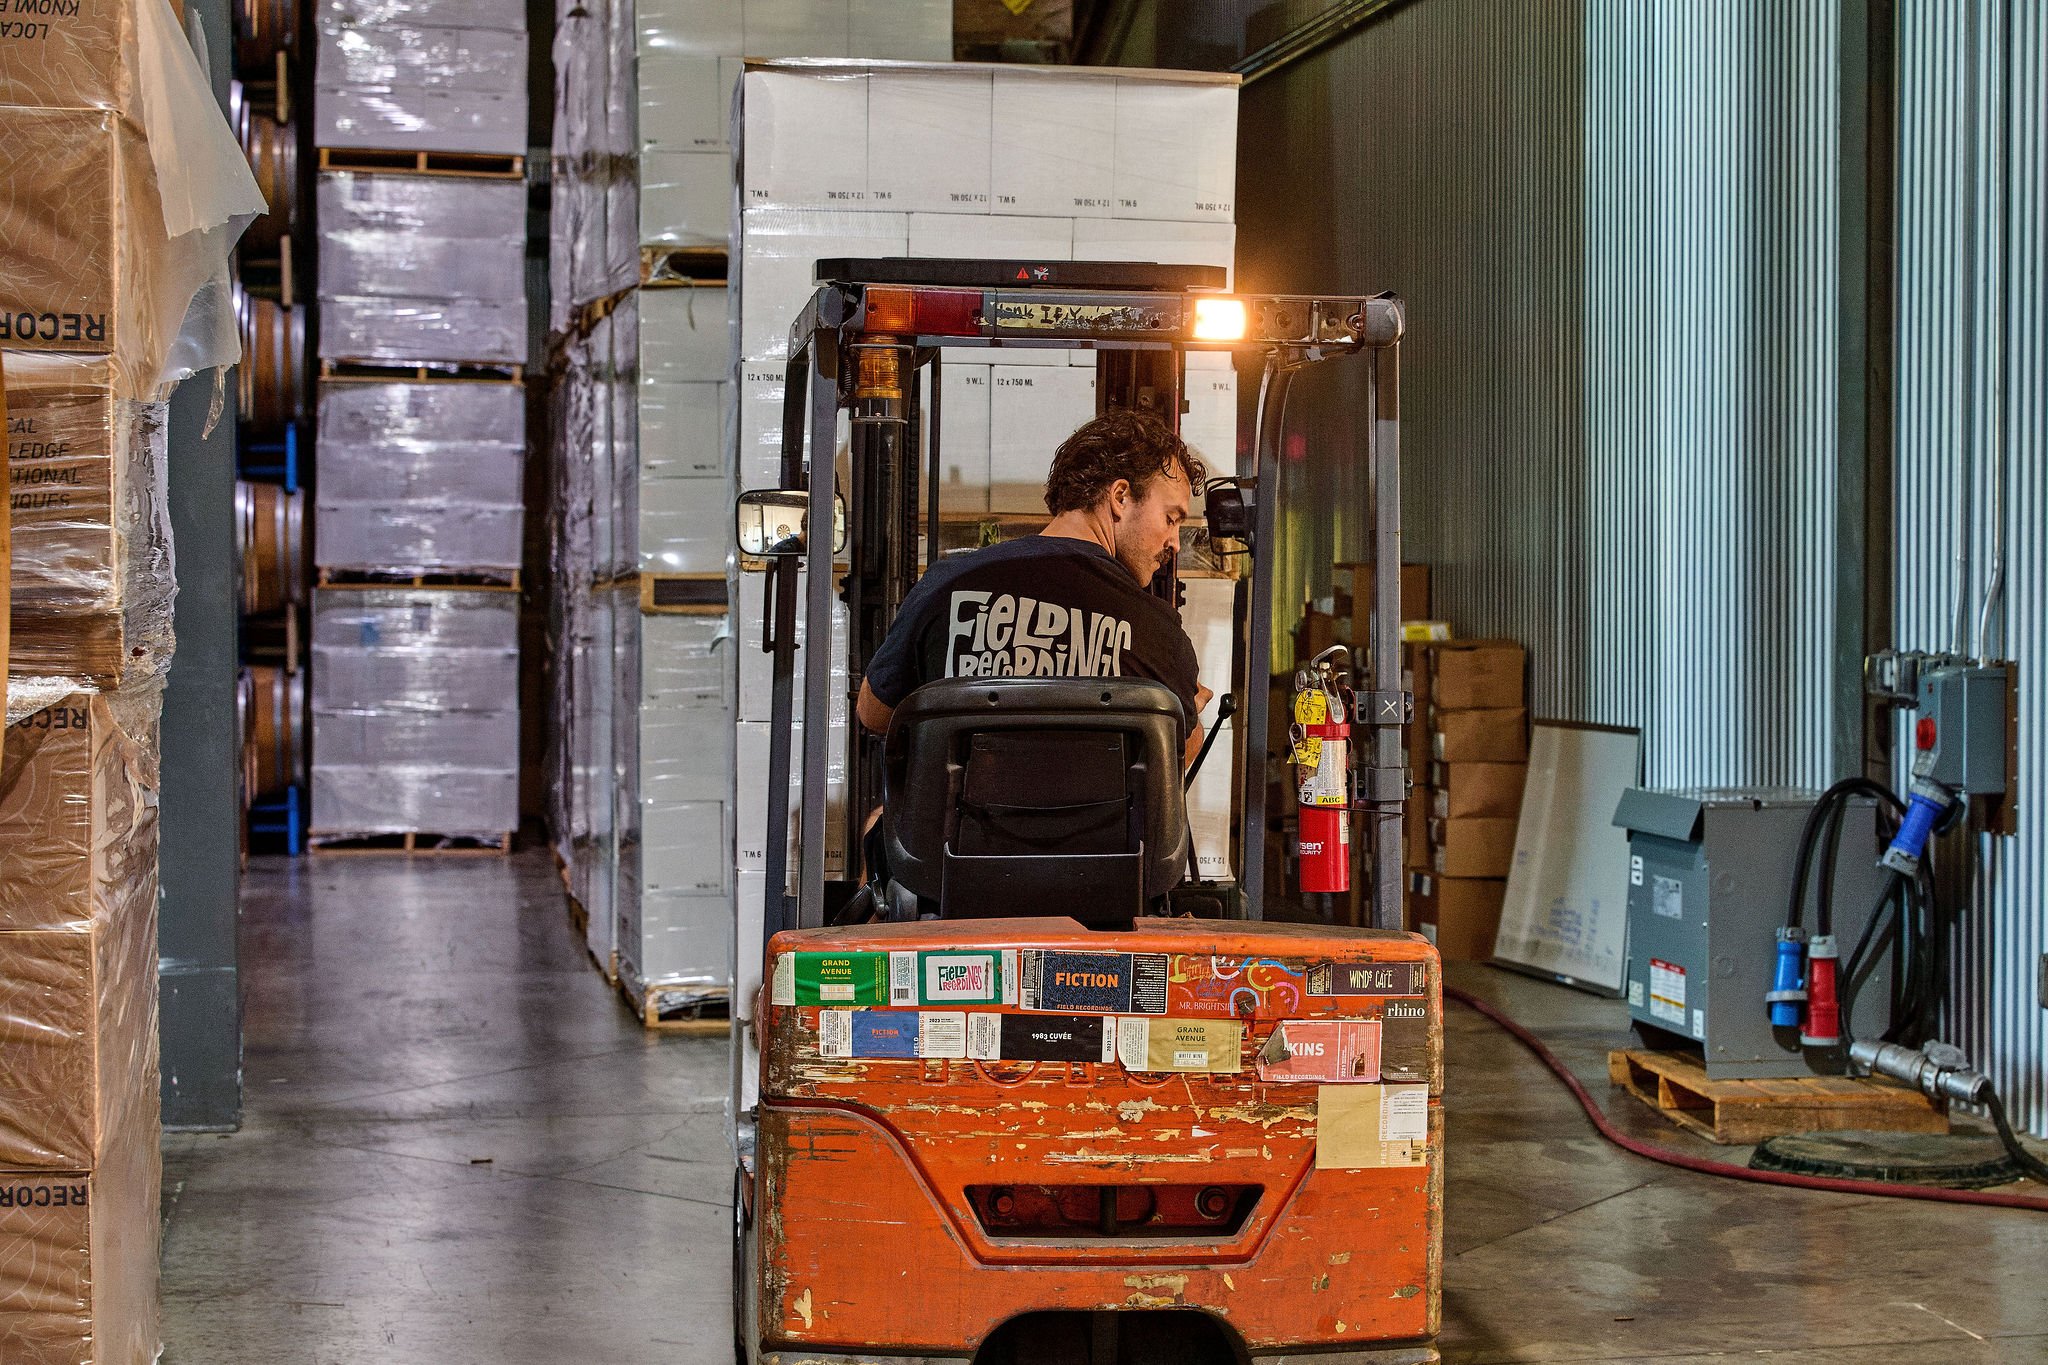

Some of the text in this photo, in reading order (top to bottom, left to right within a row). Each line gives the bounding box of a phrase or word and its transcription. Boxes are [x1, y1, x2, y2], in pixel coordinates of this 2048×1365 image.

[747, 373, 754, 382] 12
[762, 373, 774, 382] 750
[997, 378, 1005, 386] 12
[1011, 378, 1023, 386] 750
[1024, 378, 1033, 387] ML
[1321, 796, 1341, 804] ABC
[1300, 842, 1322, 850] sen
[1218, 856, 1225, 864] 12
[822, 959, 850, 967] GRAND
[1055, 972, 1119, 988] FICTION
[1179, 1001, 1193, 1010] MR.
[1386, 1003, 1426, 1016] rhino
[871, 1028, 899, 1036] FICTION
[1176, 1026, 1205, 1034] GRAND
[1031, 1031, 1072, 1040] 1983 CUVÉE
